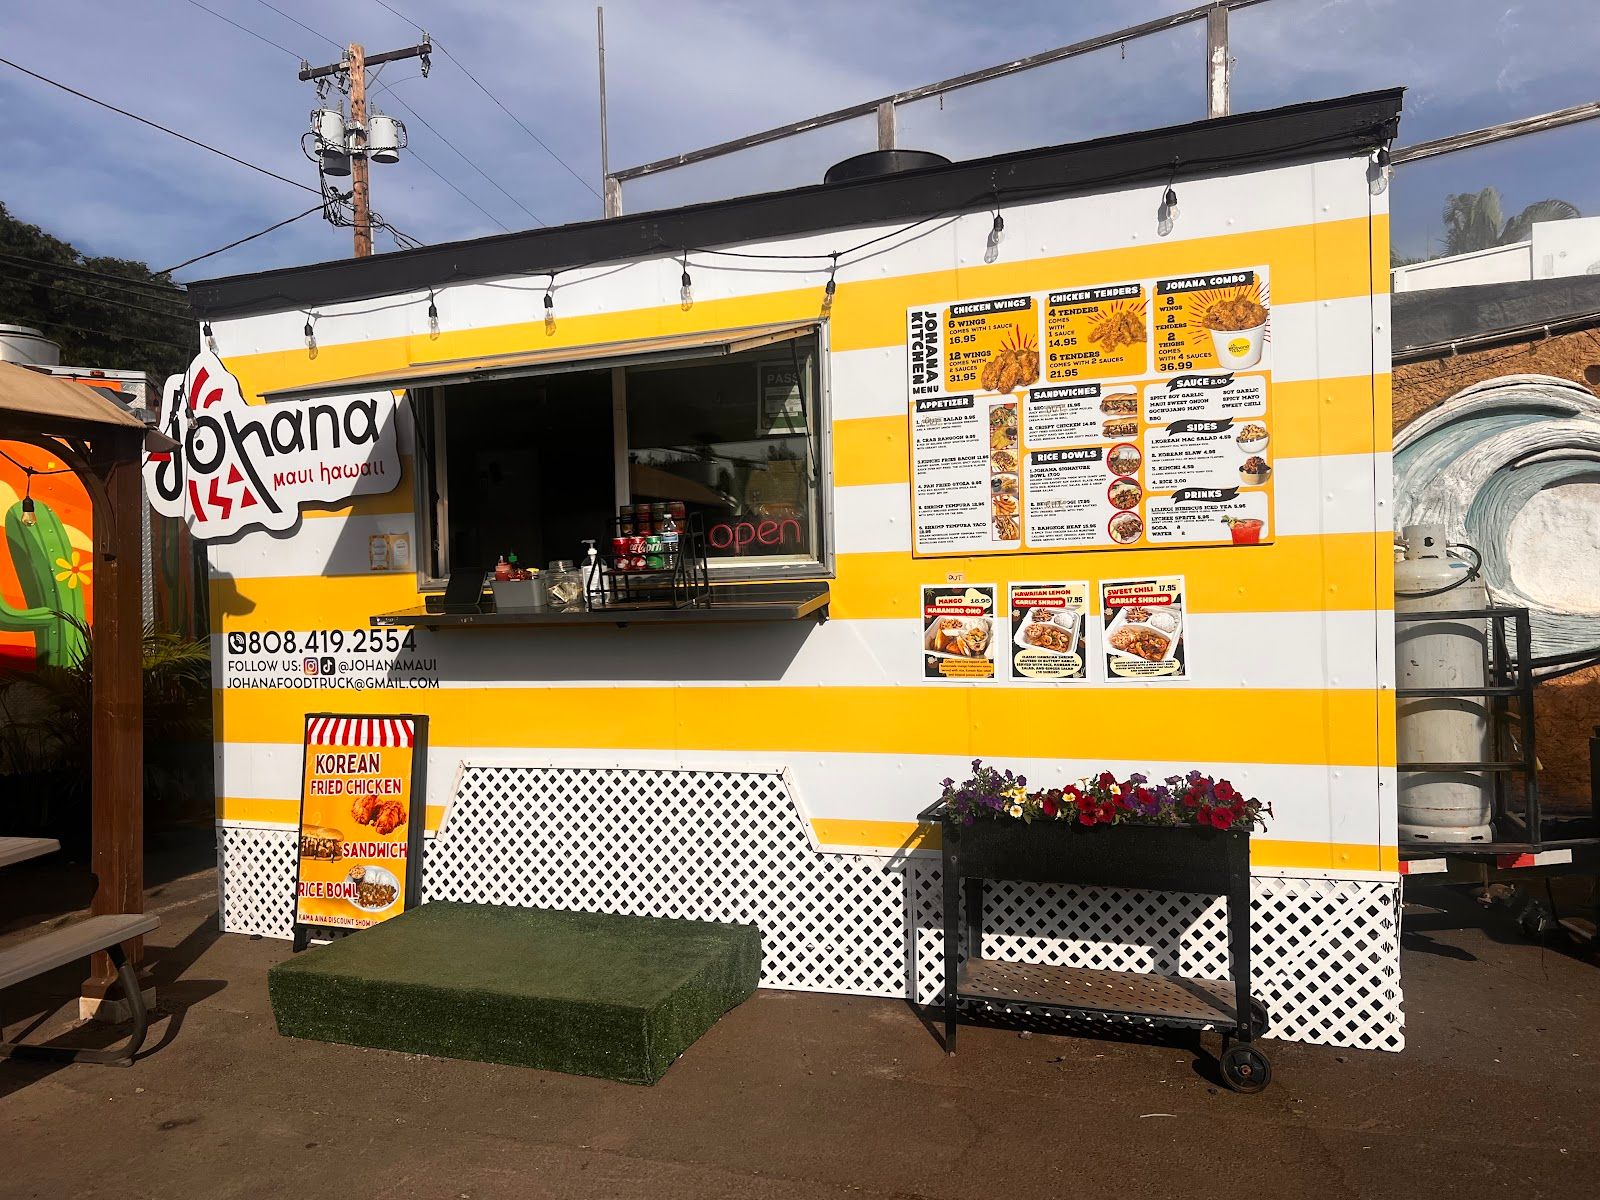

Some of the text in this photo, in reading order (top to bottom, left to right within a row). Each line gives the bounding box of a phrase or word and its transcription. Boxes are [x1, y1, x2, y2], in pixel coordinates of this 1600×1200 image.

[1166, 275, 1246, 290] JOHANA COMBO
[1051, 287, 1139, 303] CHICKEN TENDERS
[1167, 297, 1175, 305] 8
[953, 299, 1026, 314] CHICKEN WINGS
[1048, 307, 1099, 317] 4 TENDERS
[948, 319, 986, 328] 6 WINGS
[1168, 315, 1175, 323] 2
[949, 335, 976, 344] 16.95
[1168, 333, 1175, 341] 2
[925, 312, 938, 383] JOHANA
[1049, 338, 1077, 347] 14.95
[911, 312, 924, 385] KITCHEN
[949, 352, 961, 360] 12
[1049, 351, 1100, 361] 6 TENDERS
[1160, 362, 1193, 371] 36.99
[949, 373, 976, 382] 31.95
[1050, 369, 1078, 378] 21.95
[1177, 378, 1210, 388] SAUCE
[912, 385, 939, 394] MENU
[1033, 387, 1097, 399] SANDWICHES
[920, 398, 969, 409] APPETIZER
[1186, 423, 1218, 432] SIDES
[1037, 451, 1097, 461] RICE BOWLS
[1184, 490, 1222, 499] DRINKS
[709, 519, 801, 556] open
[1138, 596, 1169, 604] SHRIMP
[248, 629, 417, 654] 808.419.2554
[228, 659, 437, 674] FOLLOW US: @JOHANAMAUI
[227, 677, 440, 691] JOHANAFOODTRUCK@GMAIL.COM
[315, 753, 380, 774] KOREAN
[310, 779, 401, 795] FRIED CHICKEN
[343, 842, 408, 858] SANDWICH
[298, 882, 359, 898] RICE BOWL
[328, 916, 354, 925] DISCOUNT
[355, 918, 371, 927] SHOW
